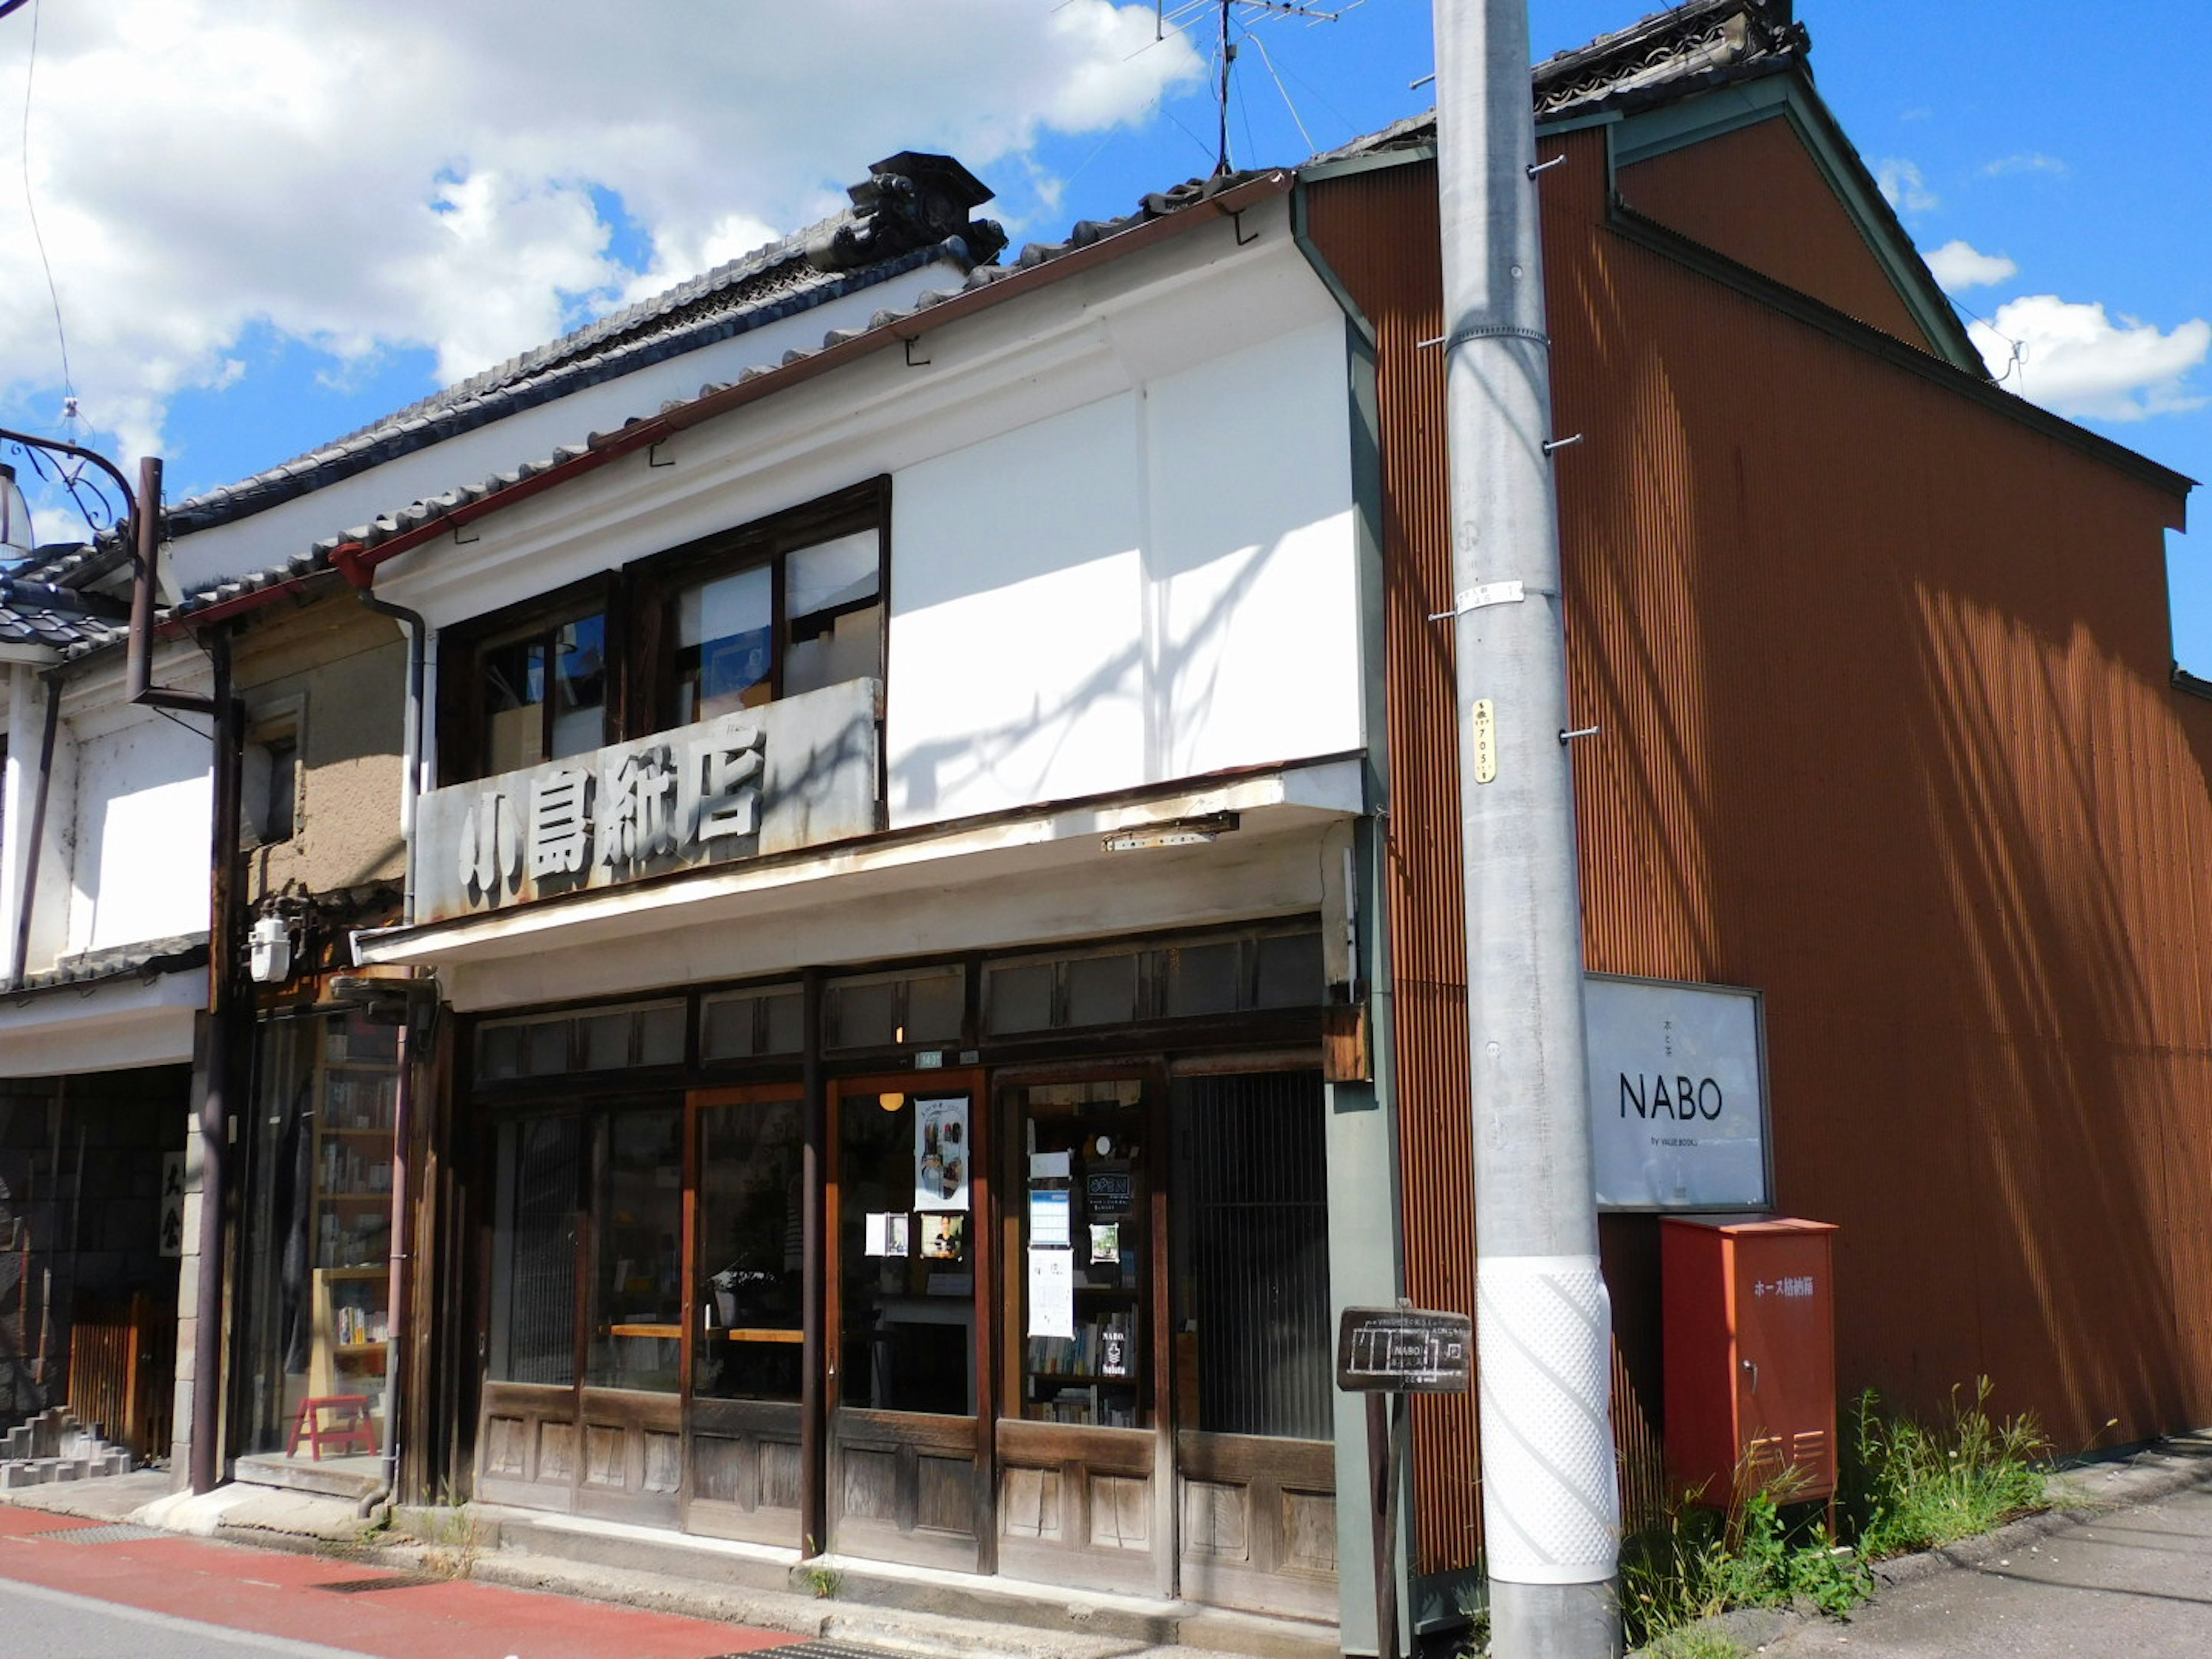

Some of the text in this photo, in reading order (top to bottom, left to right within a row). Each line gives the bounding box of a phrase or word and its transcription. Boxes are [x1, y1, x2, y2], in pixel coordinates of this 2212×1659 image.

[459, 725, 765, 892] 小島紙店
[1619, 1072, 1722, 1120] NABO
[1755, 1277, 1813, 1297] ホース格納箱
